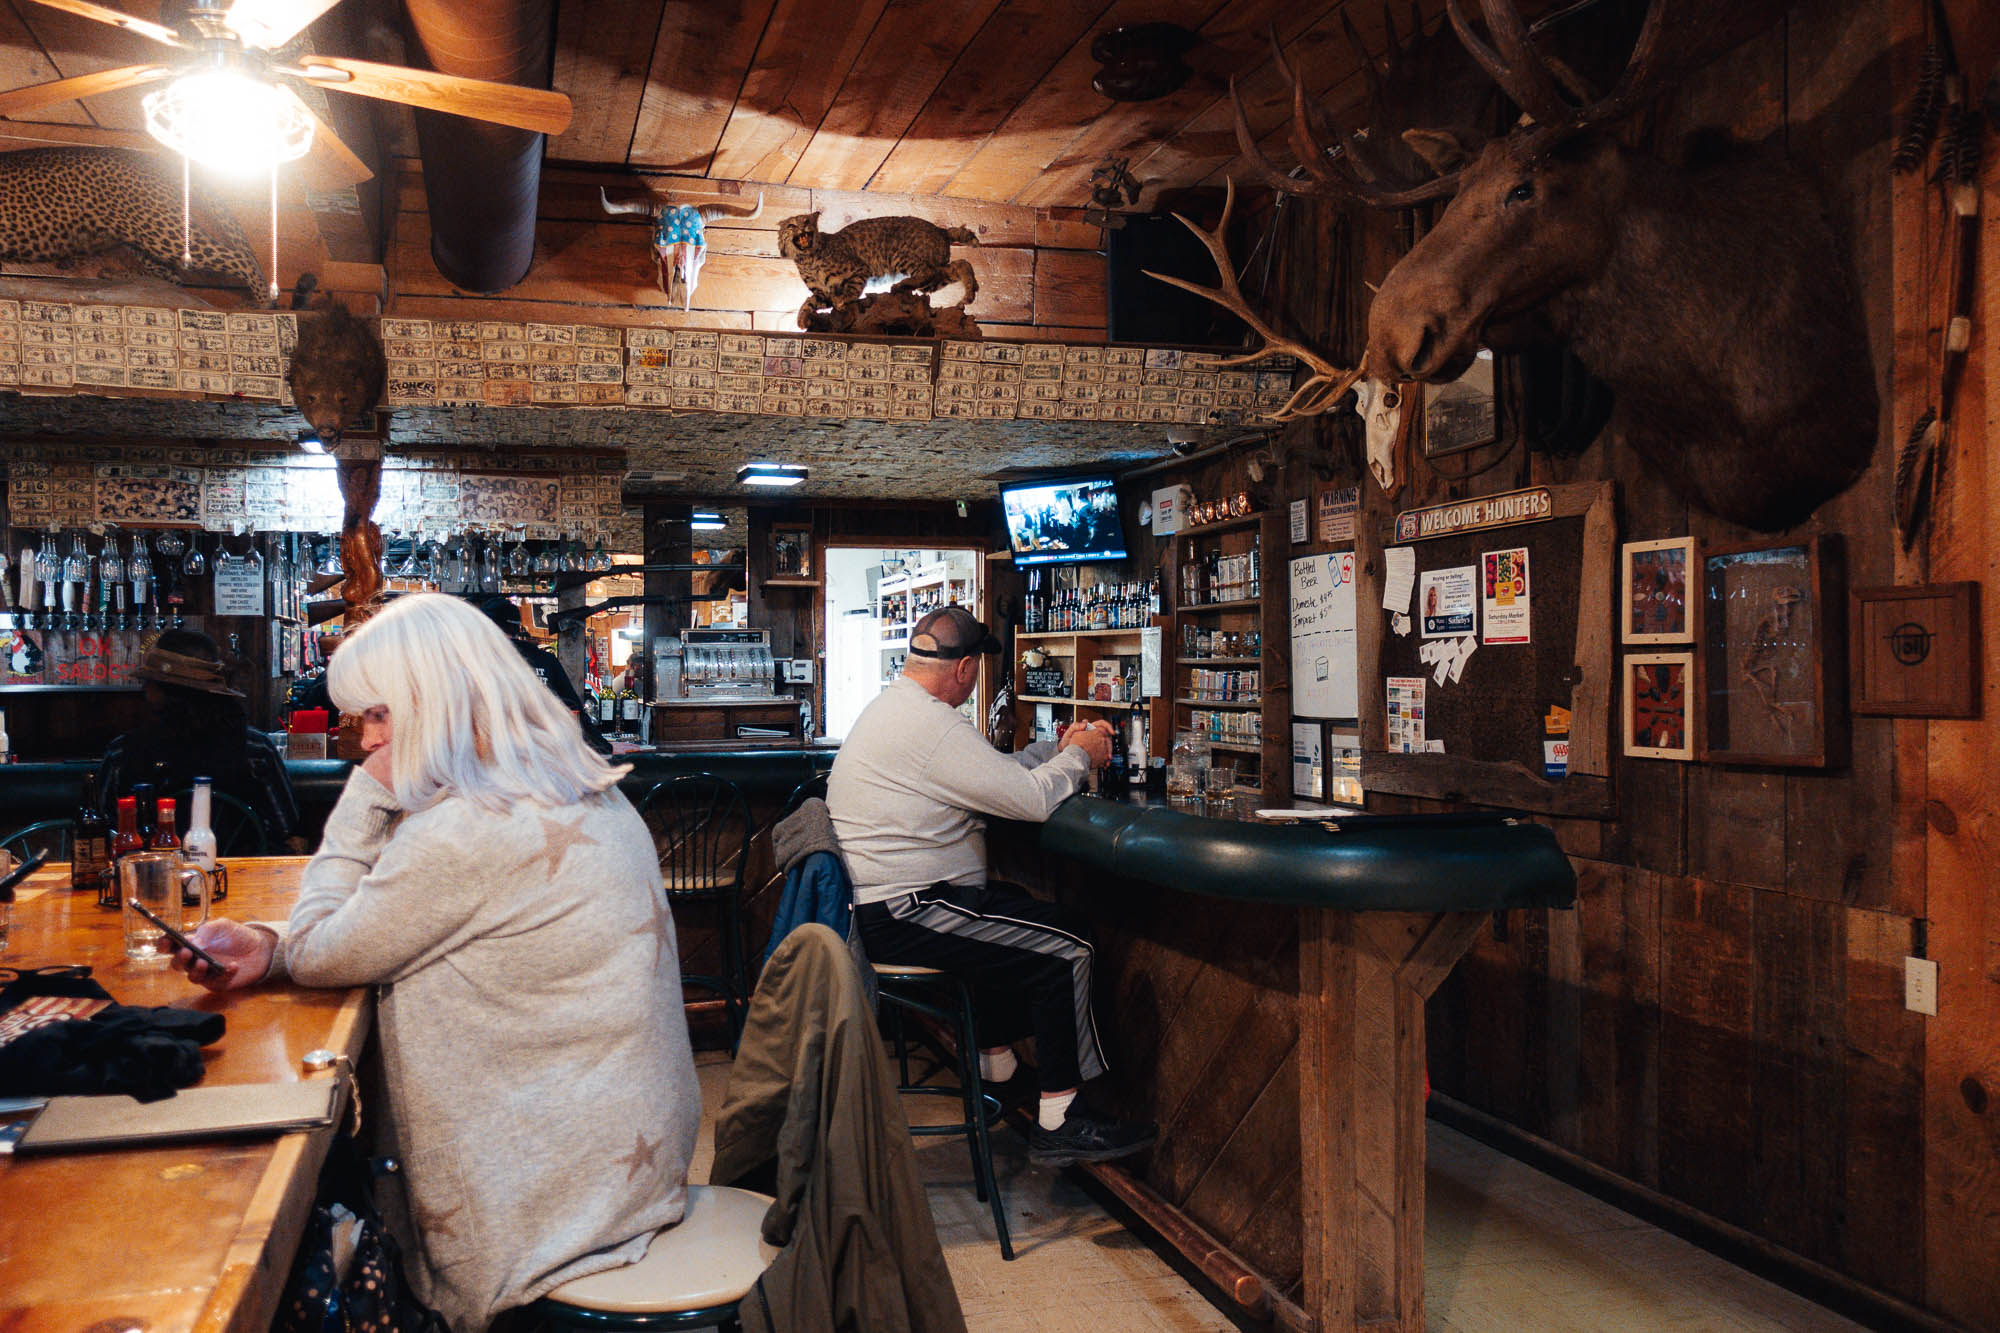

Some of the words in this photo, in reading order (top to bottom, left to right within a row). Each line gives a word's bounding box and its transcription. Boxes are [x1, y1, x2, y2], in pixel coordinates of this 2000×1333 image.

[1321, 487, 1357, 506] WARNING
[1422, 505, 1480, 532] WELCOME
[1486, 493, 1549, 521] HUNTERS
[1404, 526, 1414, 536] 66
[79, 637, 113, 657] OK
